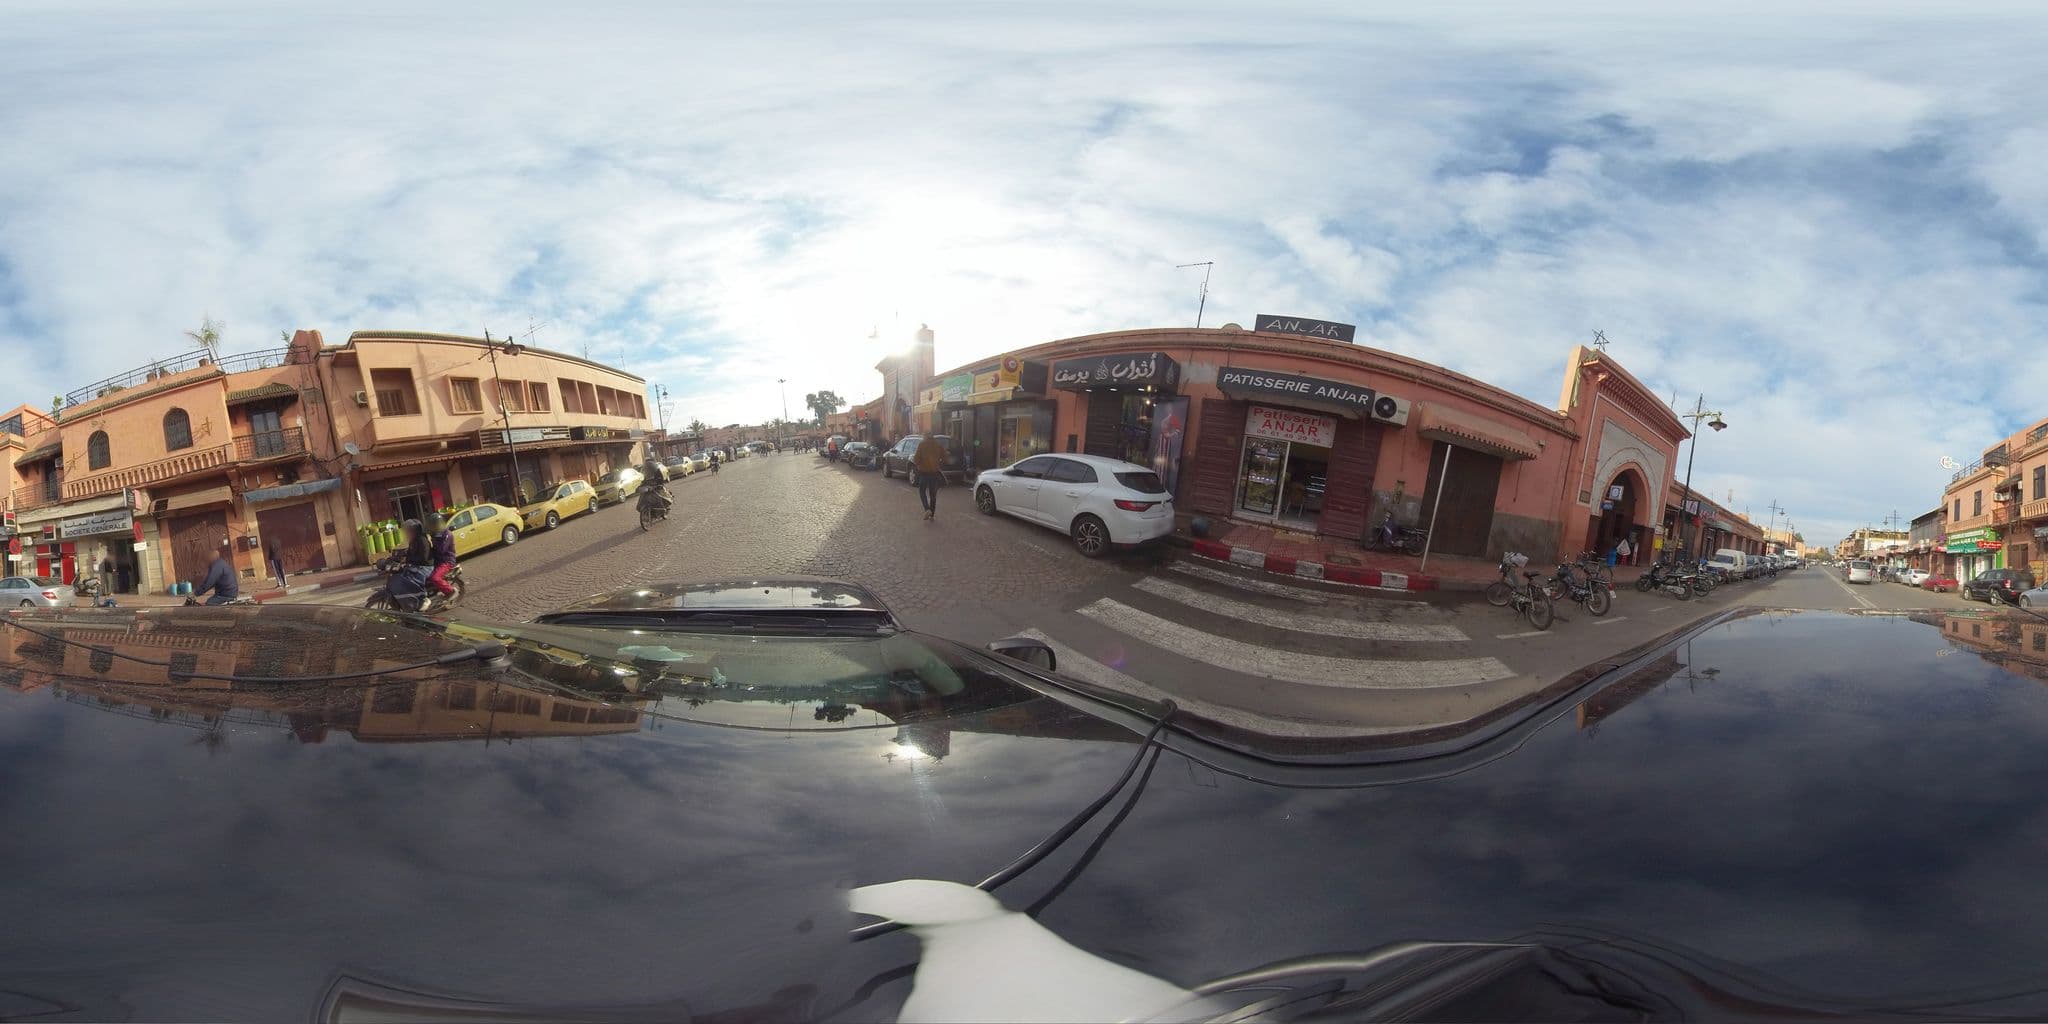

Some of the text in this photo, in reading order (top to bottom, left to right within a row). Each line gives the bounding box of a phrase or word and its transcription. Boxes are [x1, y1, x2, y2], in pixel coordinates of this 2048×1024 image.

[1055, 369, 1090, 384] يوسف
[1112, 352, 1157, 381] أثواب
[1223, 373, 1369, 405] PATISSERIE ANJAR
[1262, 420, 1318, 437] ANJAR
